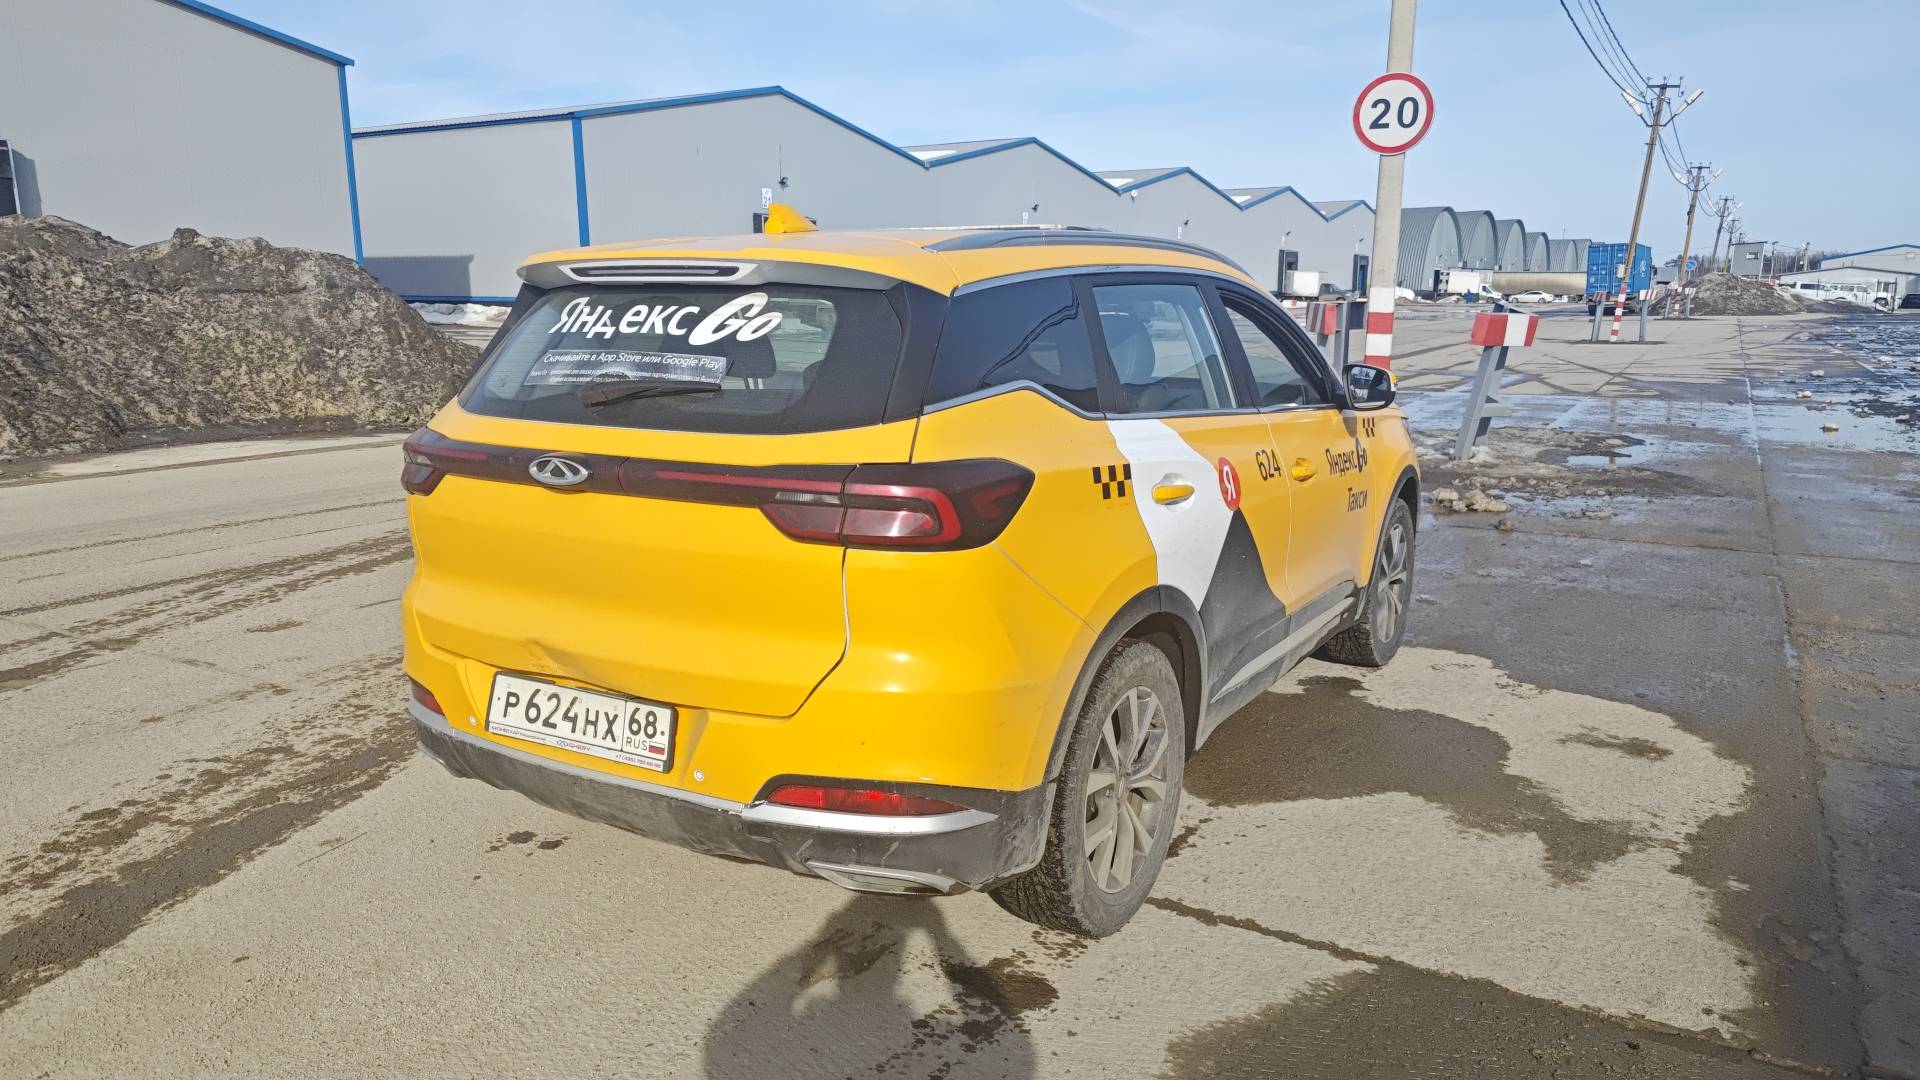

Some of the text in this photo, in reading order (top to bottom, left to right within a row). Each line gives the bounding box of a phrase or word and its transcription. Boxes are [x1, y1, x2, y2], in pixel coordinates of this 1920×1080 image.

[1369, 97, 1419, 129] 20
[548, 292, 783, 345] Яндекс Go
[543, 352, 590, 363] Скачивайте
[597, 352, 617, 363] App
[617, 352, 641, 363] Store
[641, 355, 661, 364] или
[662, 354, 698, 368] Google
[698, 357, 721, 371] Play
[1255, 449, 1281, 481] 624
[1325, 438, 1368, 477] Яндекс Go
[1223, 466, 1236, 501] Я
[1347, 487, 1368, 512] Такси
[628, 707, 658, 739] 68
[625, 736, 648, 751] RUS
